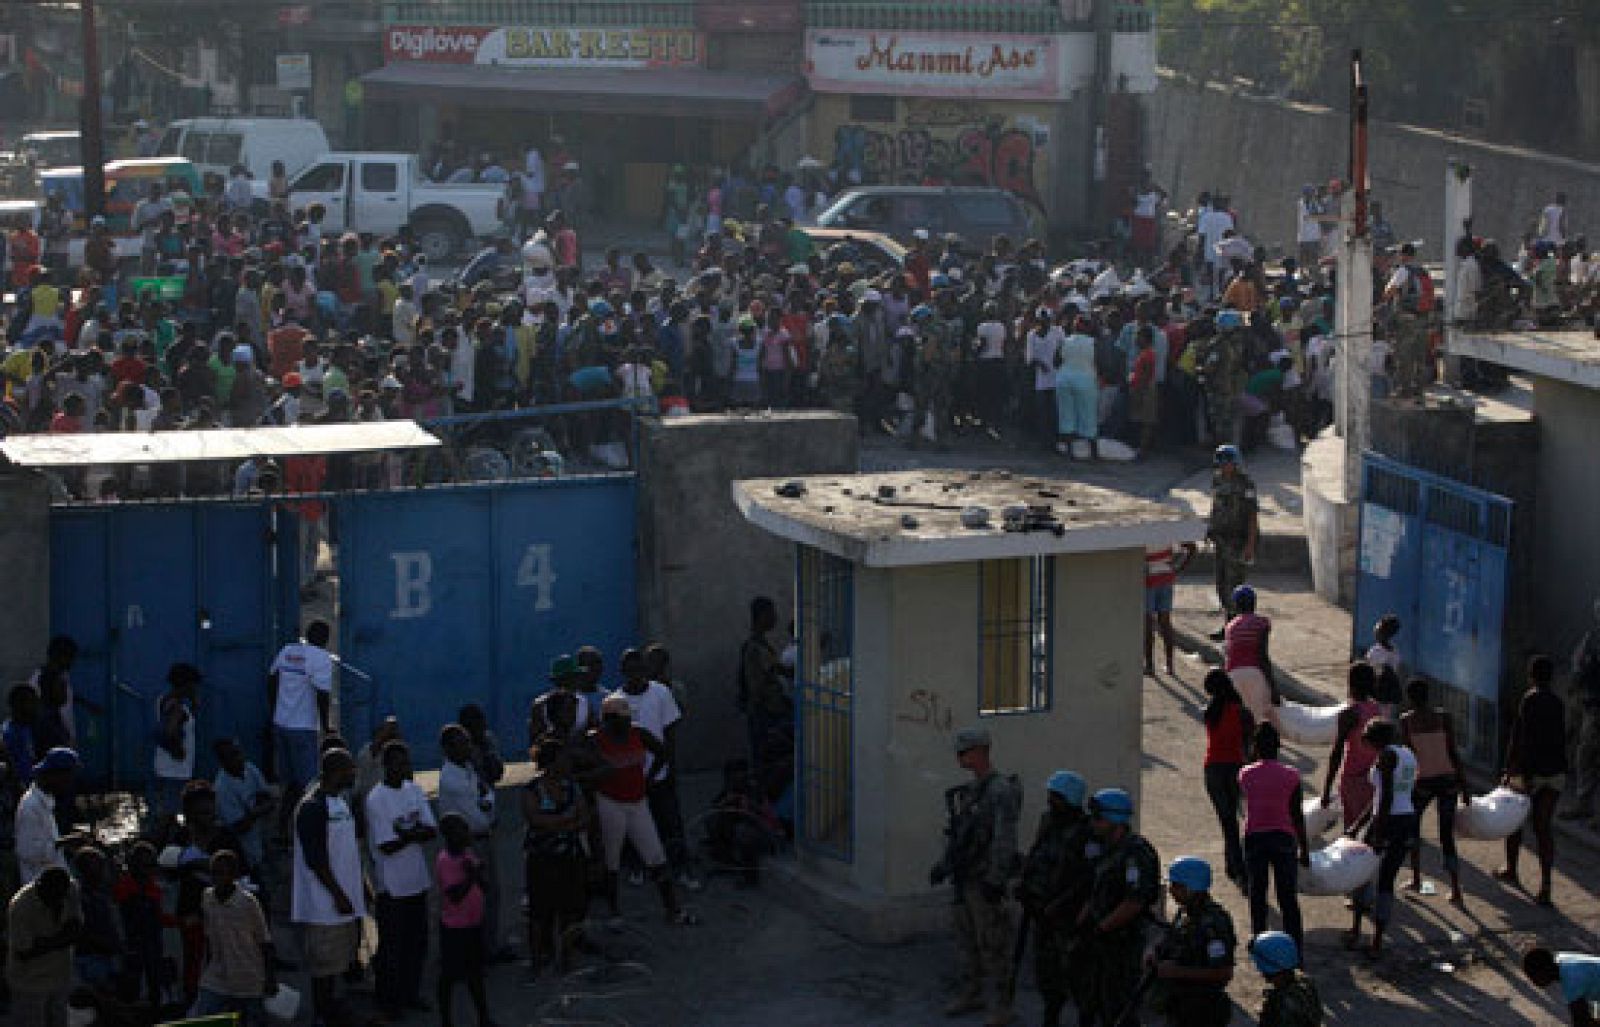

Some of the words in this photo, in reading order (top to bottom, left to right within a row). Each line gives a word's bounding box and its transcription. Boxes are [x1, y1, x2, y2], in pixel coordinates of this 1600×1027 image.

[391, 28, 478, 59] Digilove
[506, 30, 695, 59] BAR-RESTO
[855, 32, 975, 74] Manmi
[389, 552, 432, 618] B
[518, 544, 557, 610] 4
